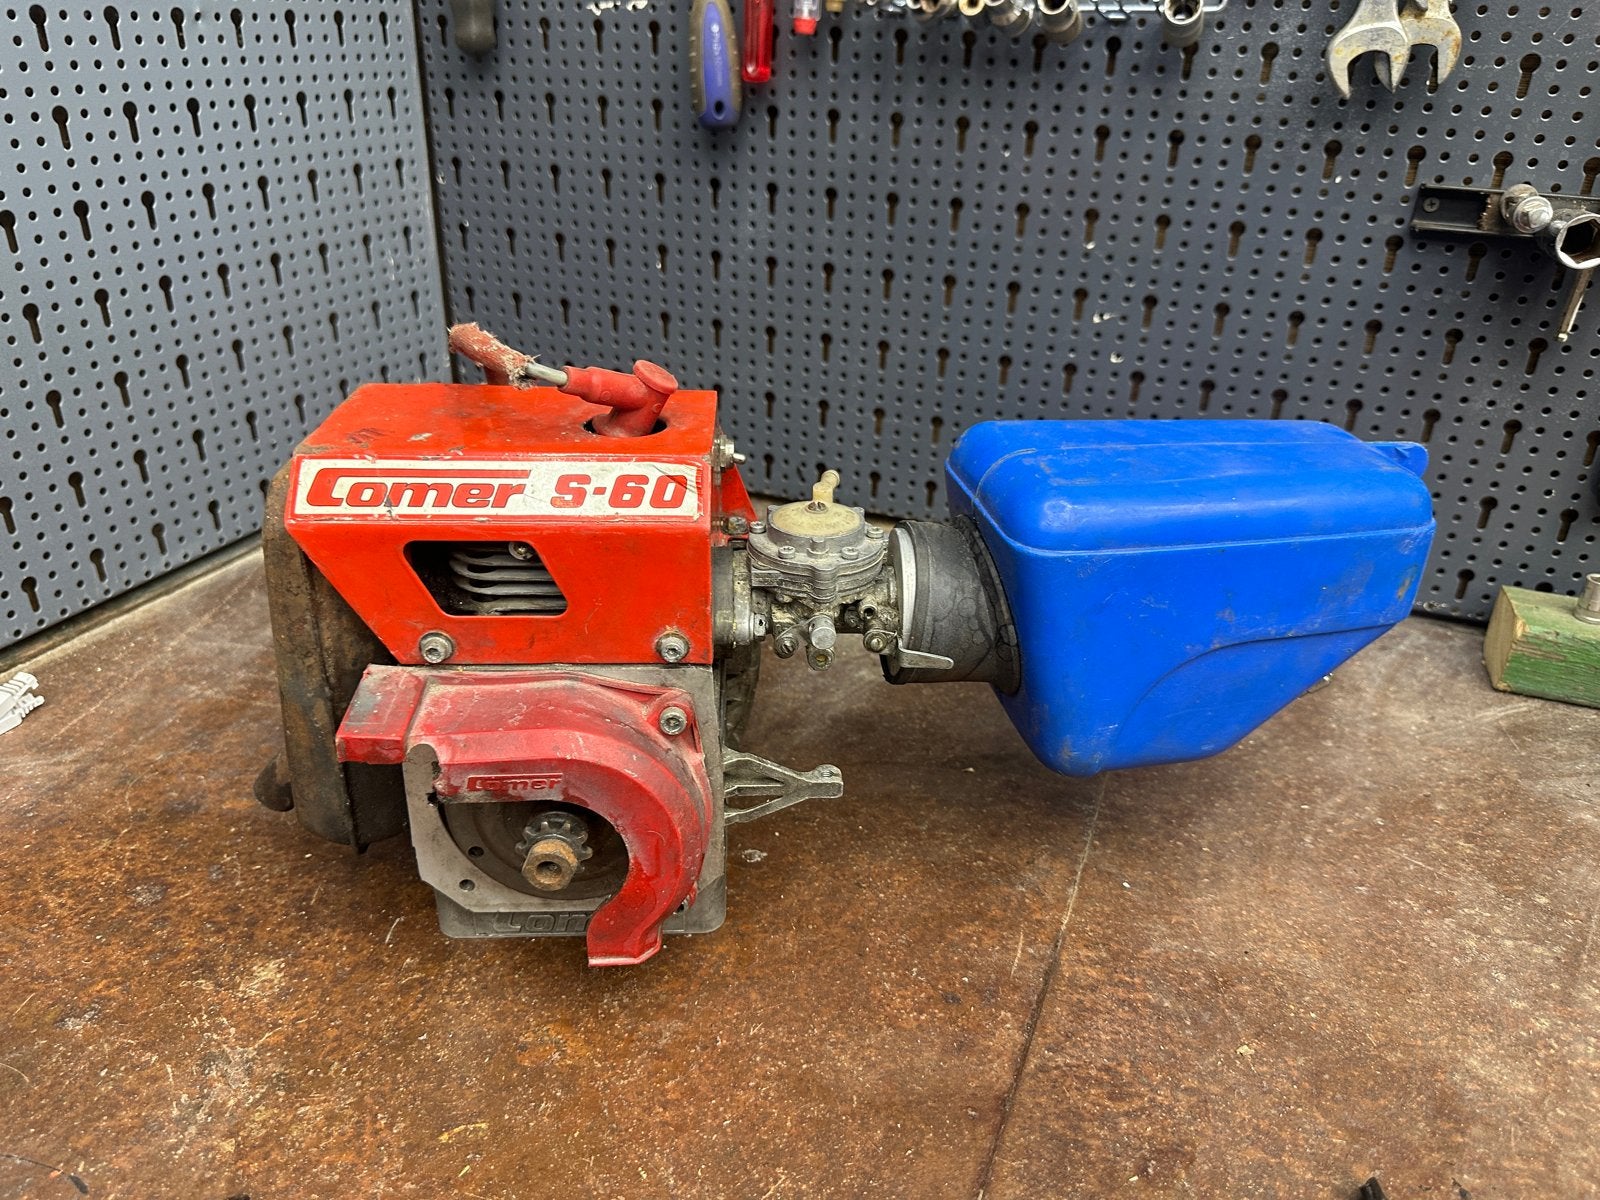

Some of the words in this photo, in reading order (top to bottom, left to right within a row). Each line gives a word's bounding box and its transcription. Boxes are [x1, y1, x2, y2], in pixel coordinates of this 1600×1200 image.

[306, 467, 532, 509] Comer
[550, 473, 688, 509] S-60
[467, 773, 563, 792] Comer
